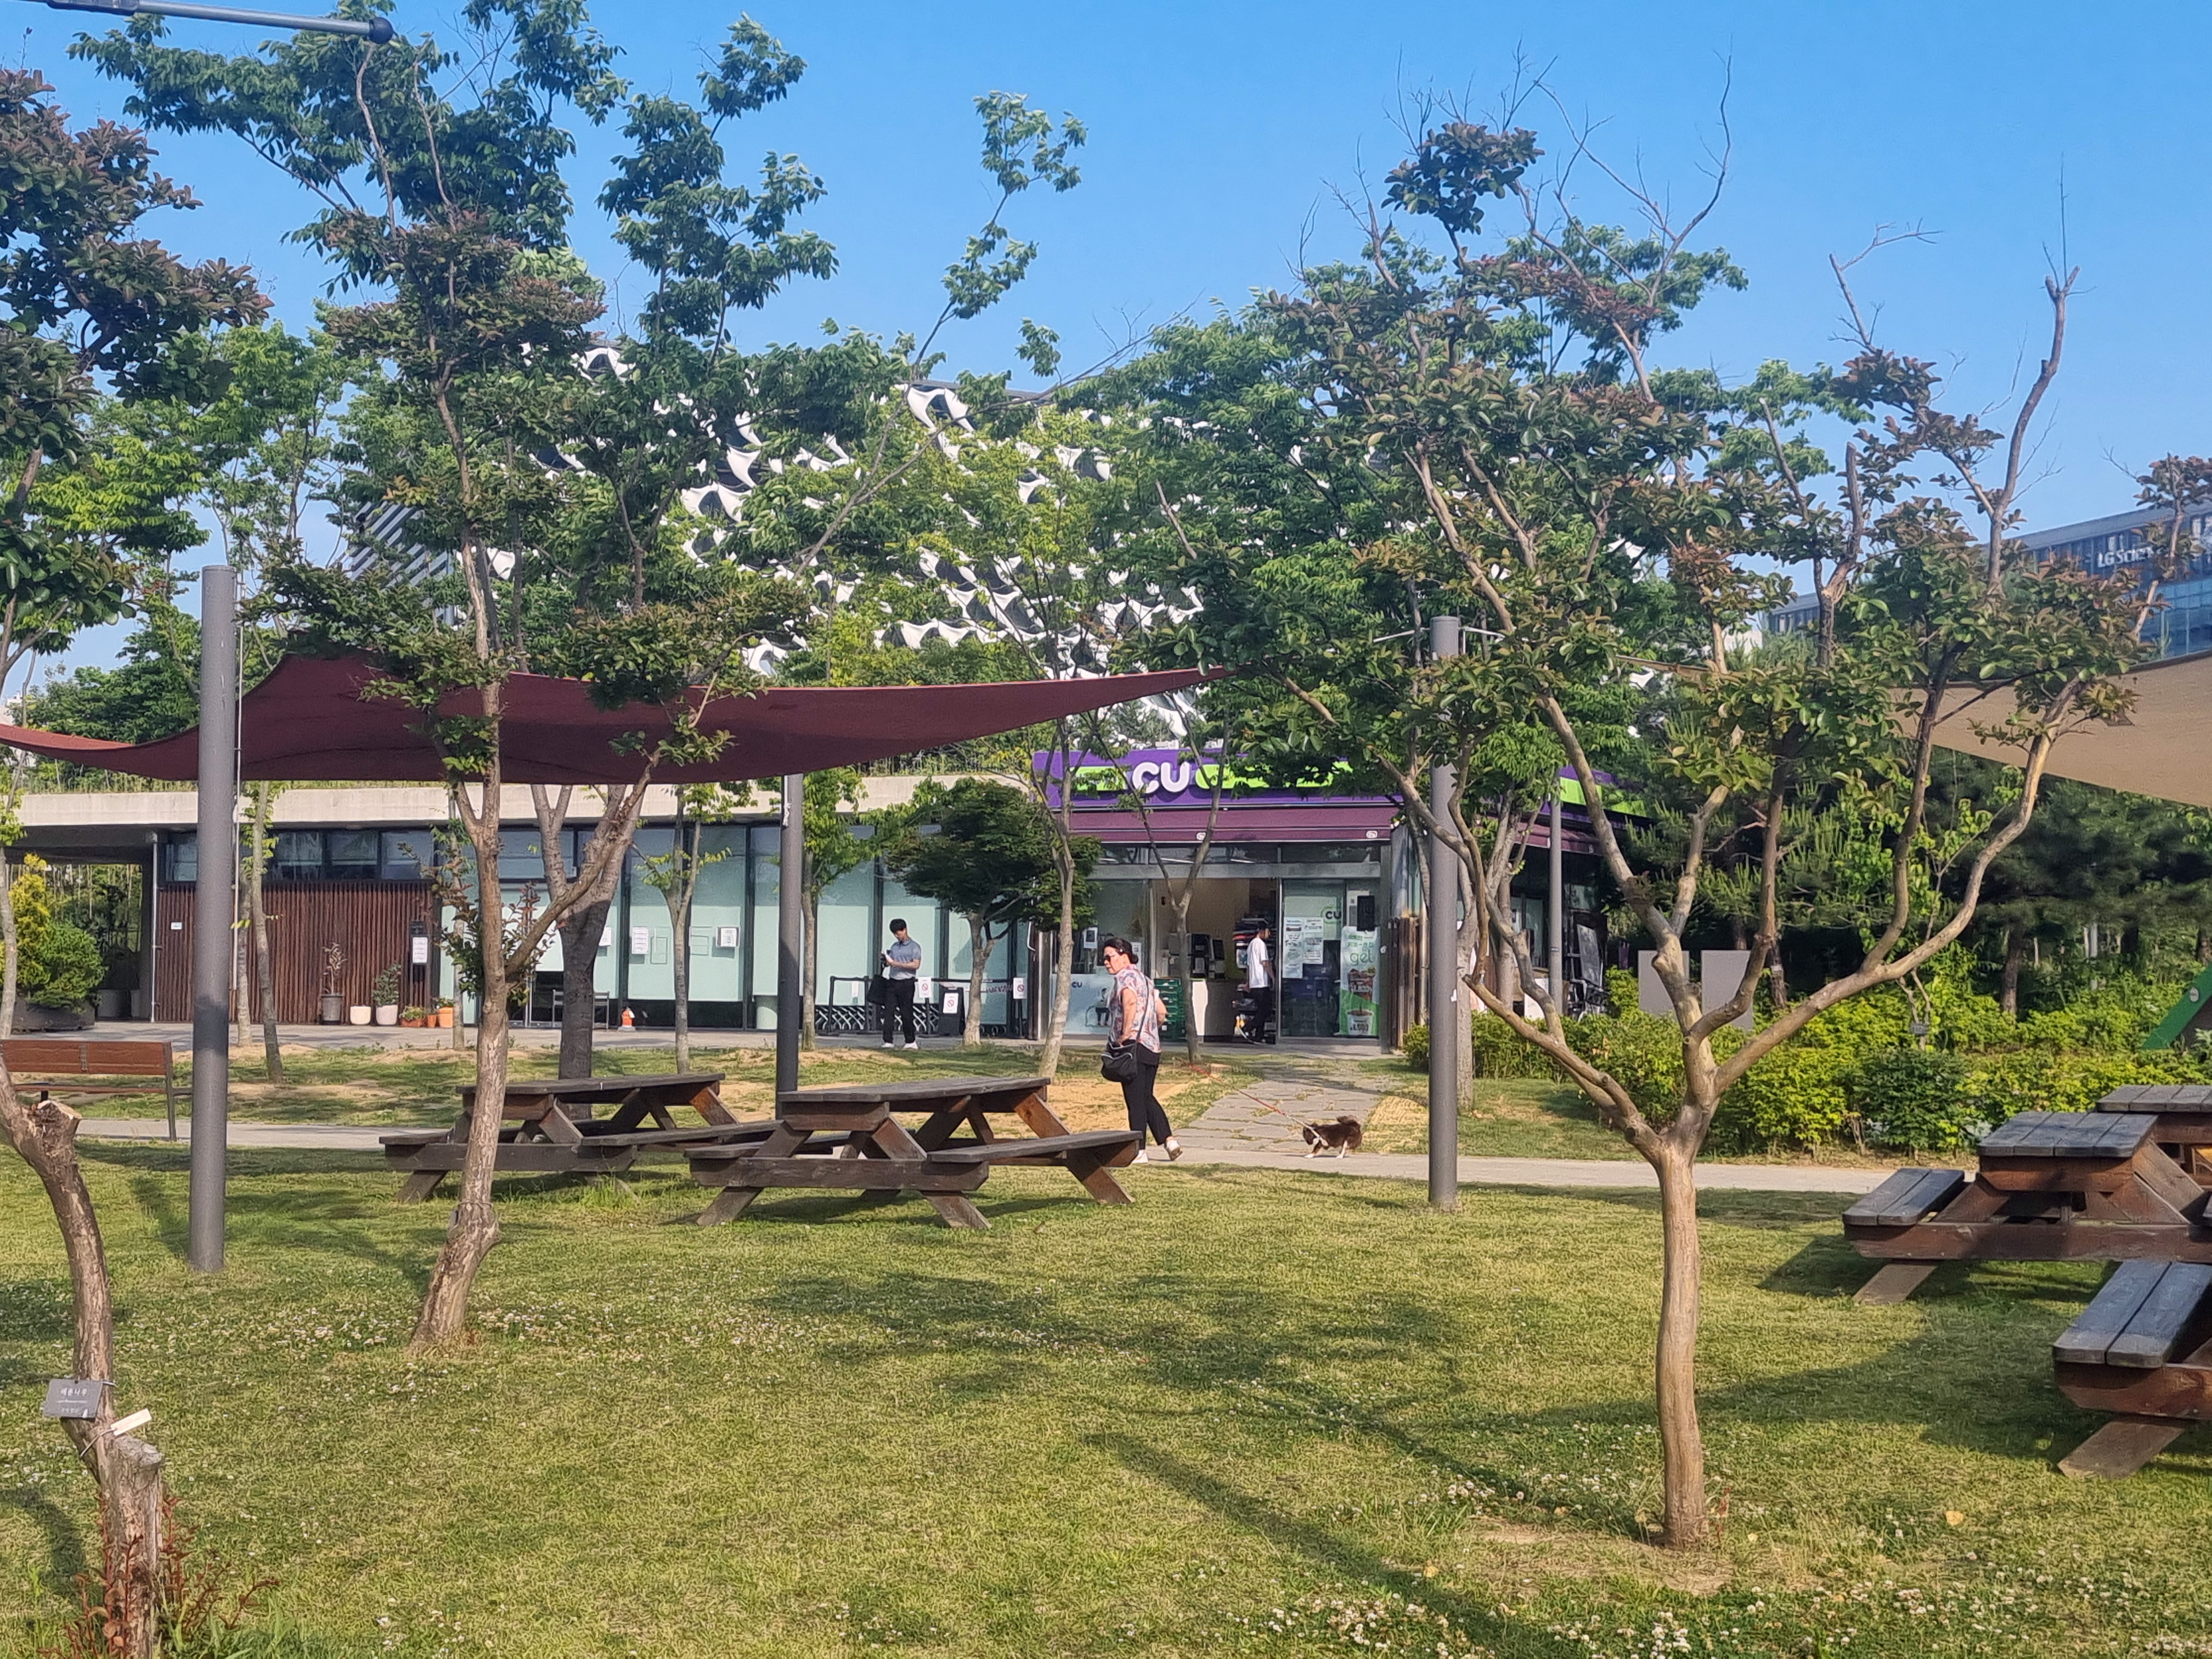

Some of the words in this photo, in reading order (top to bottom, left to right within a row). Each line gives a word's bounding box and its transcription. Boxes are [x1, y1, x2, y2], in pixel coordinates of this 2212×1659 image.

[2097, 551, 2115, 567] LG
[1132, 761, 1190, 794] CU
[1325, 911, 1341, 919] CU
